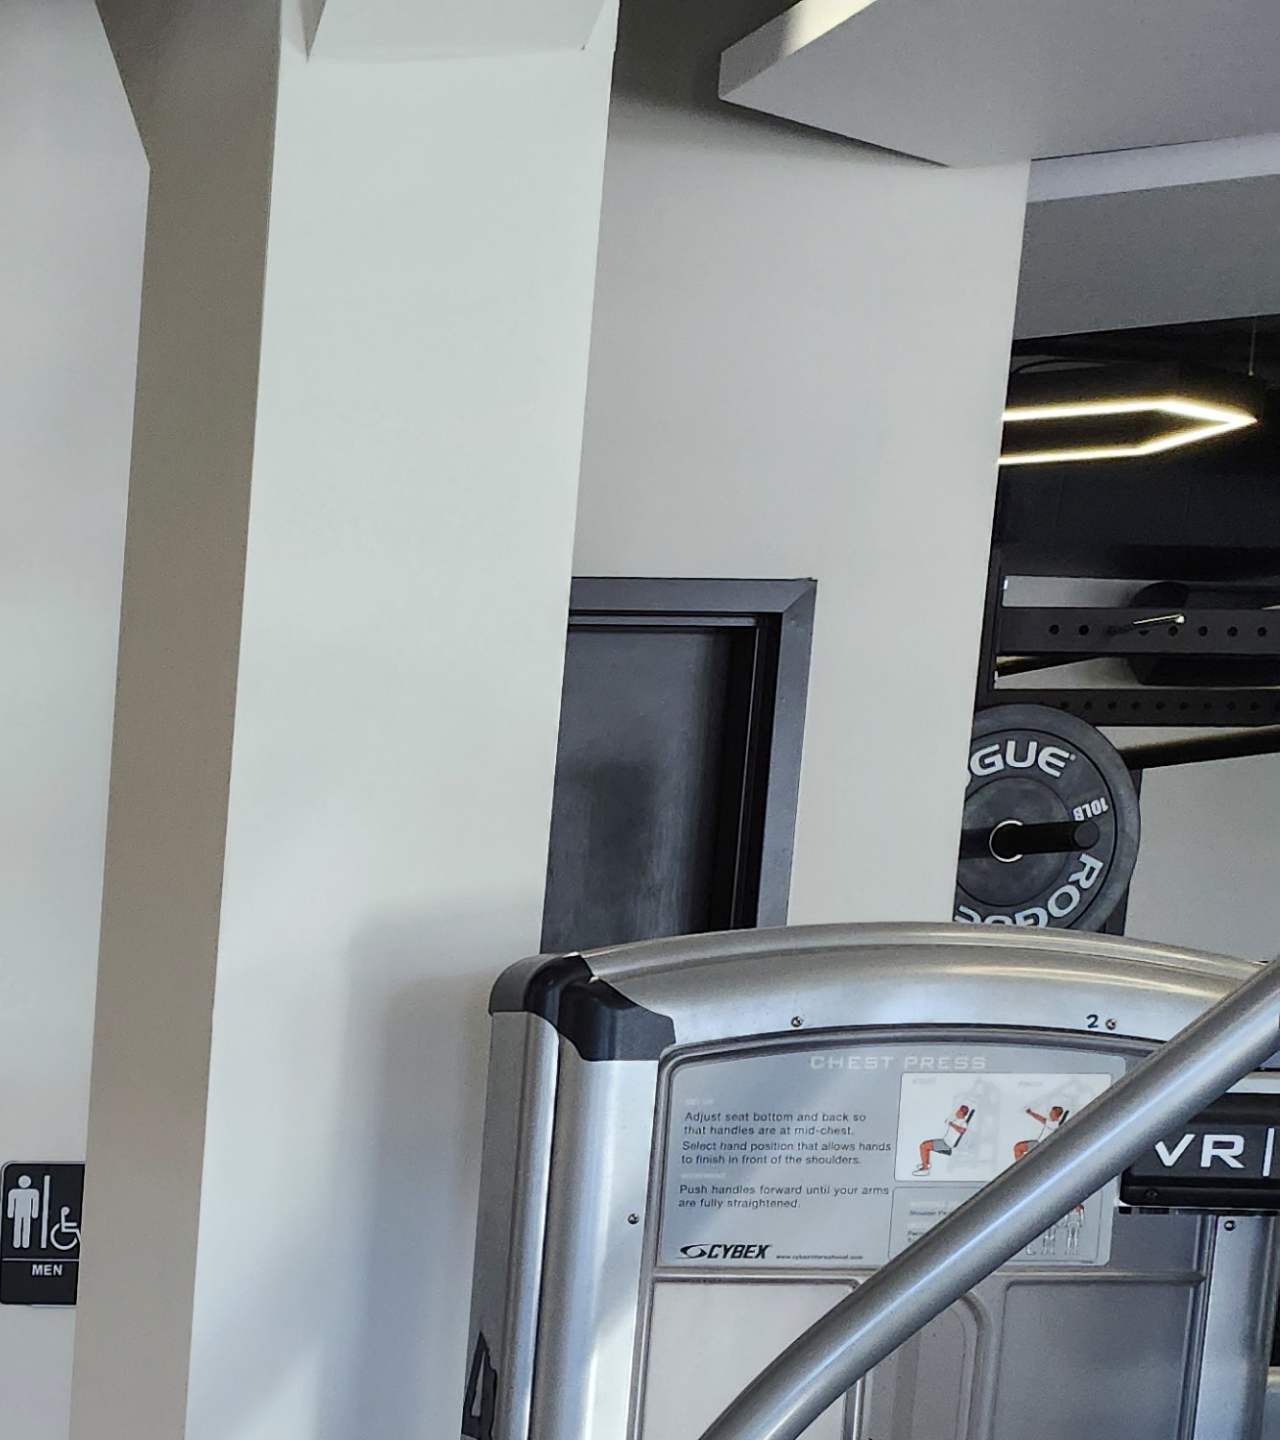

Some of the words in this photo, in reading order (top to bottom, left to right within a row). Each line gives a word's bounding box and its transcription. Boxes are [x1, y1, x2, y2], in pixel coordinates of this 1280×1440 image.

[970, 740, 1072, 778] GUE
[1073, 797, 1109, 821] 10LB
[1086, 1014, 1099, 1028] 2
[810, 1056, 893, 1070] CHEST
[904, 1056, 987, 1069] PRESS
[685, 1112, 721, 1124] Adjust
[725, 1112, 749, 1122] seat
[753, 1112, 793, 1122] bottom
[797, 1112, 818, 1122] and
[822, 1112, 848, 1122] back
[853, 1114, 866, 1122] so
[684, 1126, 706, 1136] that
[710, 1126, 754, 1136] handles
[758, 1127, 776, 1136] are
[780, 1126, 791, 1136] at
[794, 1126, 854, 1136] mid-chest.
[682, 1141, 717, 1151] Select
[720, 1141, 747, 1151] hand
[750, 1141, 794, 1153] position
[797, 1142, 818, 1151] that
[821, 1142, 855, 1151] allows
[859, 1142, 893, 1151] hands
[1155, 1133, 1246, 1168] VR
[681, 1155, 693, 1164] to
[696, 1155, 725, 1164] finish
[729, 1155, 738, 1164] in
[742, 1155, 767, 1164] front
[770, 1155, 782, 1165] of
[785, 1156, 802, 1165] the
[805, 1155, 861, 1165] shoulders.
[680, 1184, 708, 1194] Push
[711, 1185, 756, 1195] handles
[760, 1185, 802, 1195] forward
[806, 1186, 830, 1195] until
[833, 1187, 858, 1198] your
[862, 1187, 889, 1195] arms
[678, 1200, 696, 1208] are
[700, 1198, 723, 1209] fully
[706, 1244, 771, 1259] CYBEX
[32, 1264, 63, 1276] MEN
